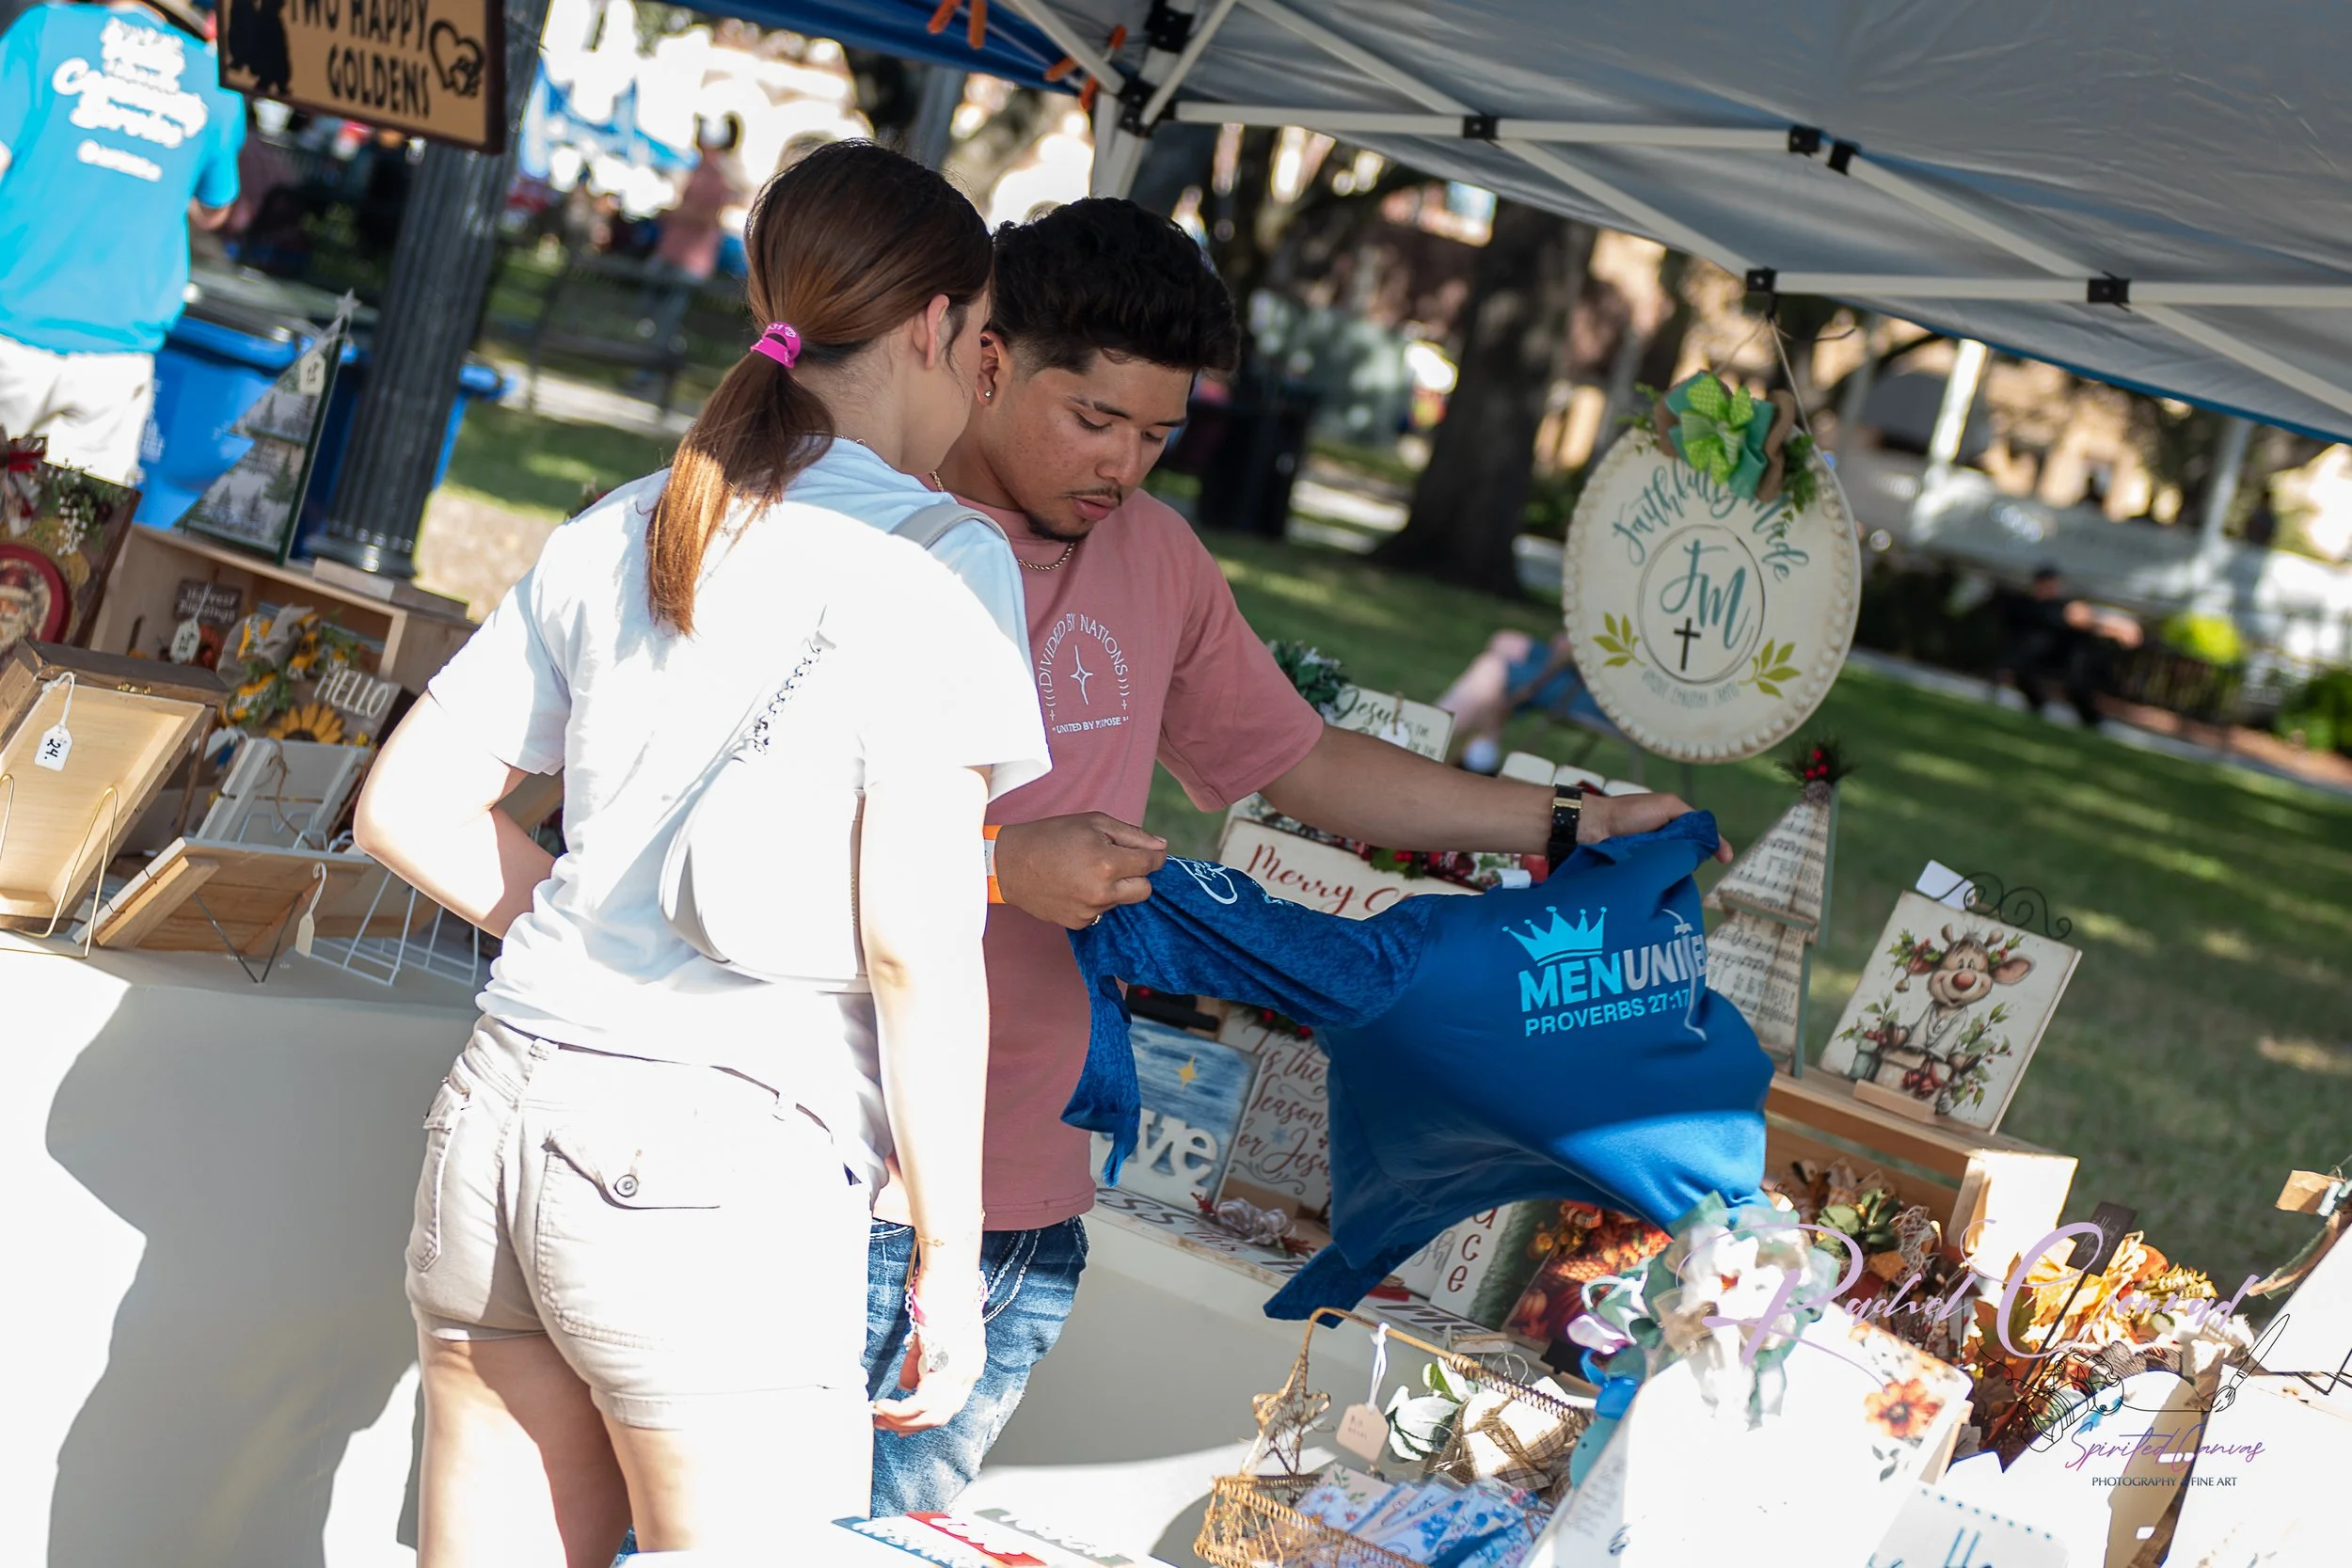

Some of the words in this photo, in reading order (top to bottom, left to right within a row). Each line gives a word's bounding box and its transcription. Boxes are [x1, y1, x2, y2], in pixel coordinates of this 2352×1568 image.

[348, 0, 430, 51] HAPPY
[327, 43, 430, 119] GOLDENS
[1038, 620, 1066, 688] DIVIDED
[1065, 612, 1075, 632] BY
[1079, 613, 1129, 676] NATIONS
[313, 670, 389, 720] HELLO
[1335, 688, 1396, 727] Jesu
[1056, 721, 1082, 734] UNITED
[1083, 720, 1095, 731] BY
[1248, 843, 1356, 915] Merry
[1526, 998, 1645, 1037] PROVERBS
[1647, 988, 1691, 1014] 27:17
[1280, 1042, 1328, 1083] the
[1262, 1127, 1330, 1180] Jesu
